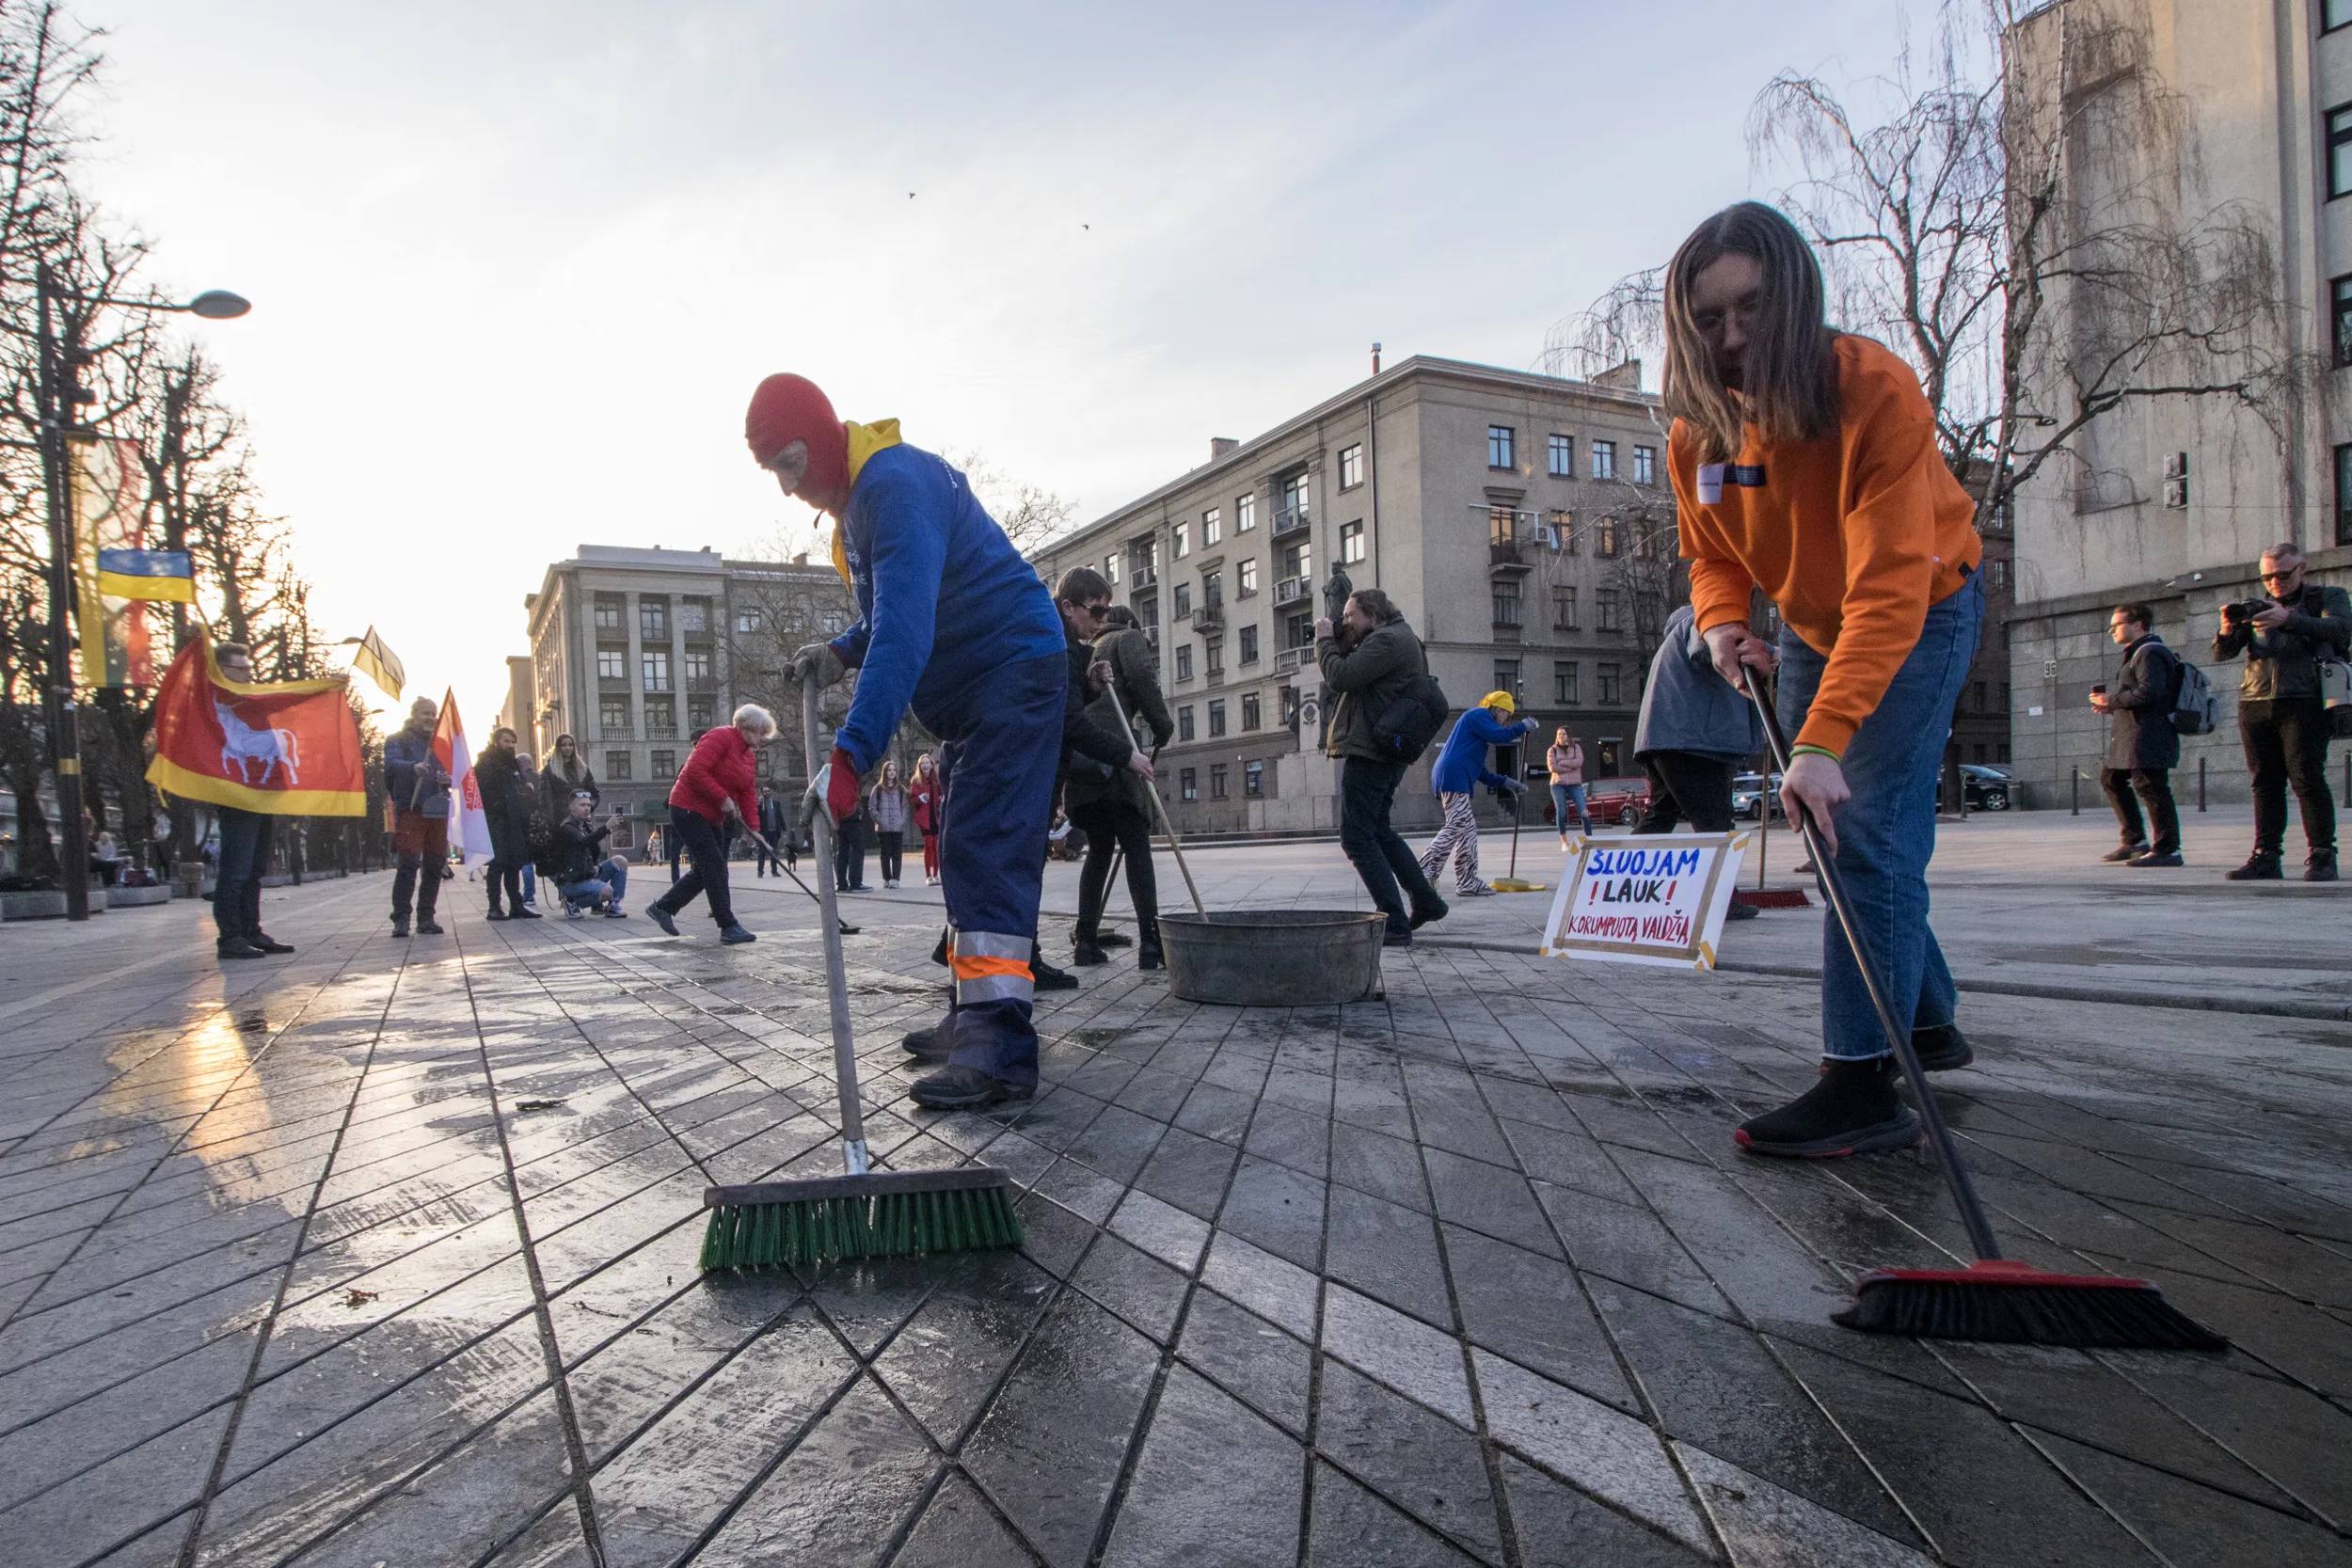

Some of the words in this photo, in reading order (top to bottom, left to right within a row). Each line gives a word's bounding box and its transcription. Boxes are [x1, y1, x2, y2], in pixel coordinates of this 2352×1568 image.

[2045, 662, 2056, 675] 96
[1586, 847, 1700, 877] ŠLUOJAM
[1566, 914, 1638, 942] KORUMPUOTĄ
[1642, 909, 1690, 944] VALDŽIĄ
